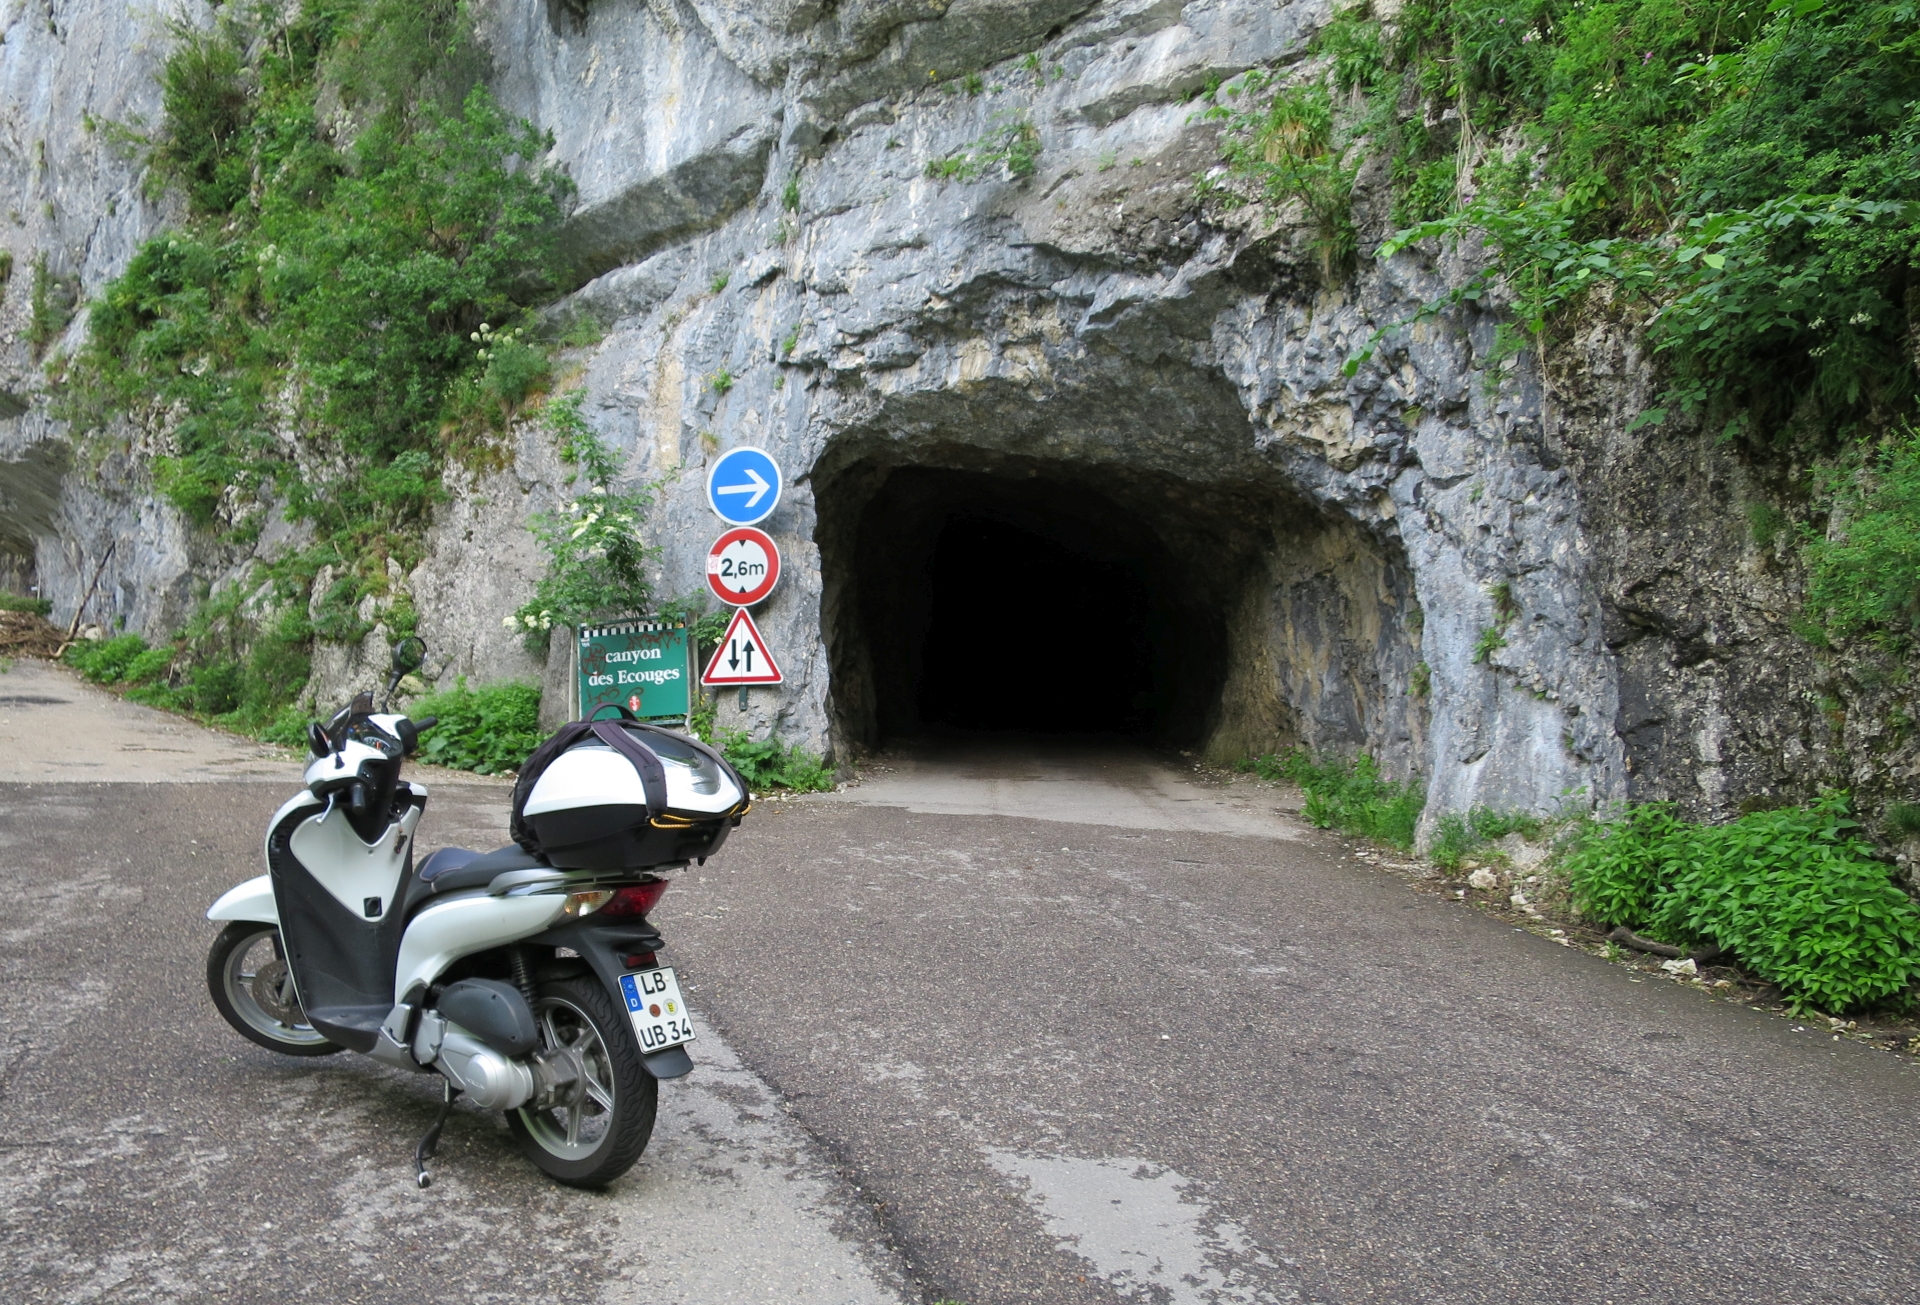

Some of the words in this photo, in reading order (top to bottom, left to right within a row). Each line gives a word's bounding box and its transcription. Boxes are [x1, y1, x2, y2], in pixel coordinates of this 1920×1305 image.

[721, 558, 764, 579] 2,6m
[605, 648, 661, 664] canyon
[588, 671, 613, 686] des
[617, 668, 680, 685] Ecouges
[641, 972, 666, 995] LB
[630, 998, 638, 1007] D
[640, 1025, 667, 1048] UB
[667, 1018, 691, 1040] 34
